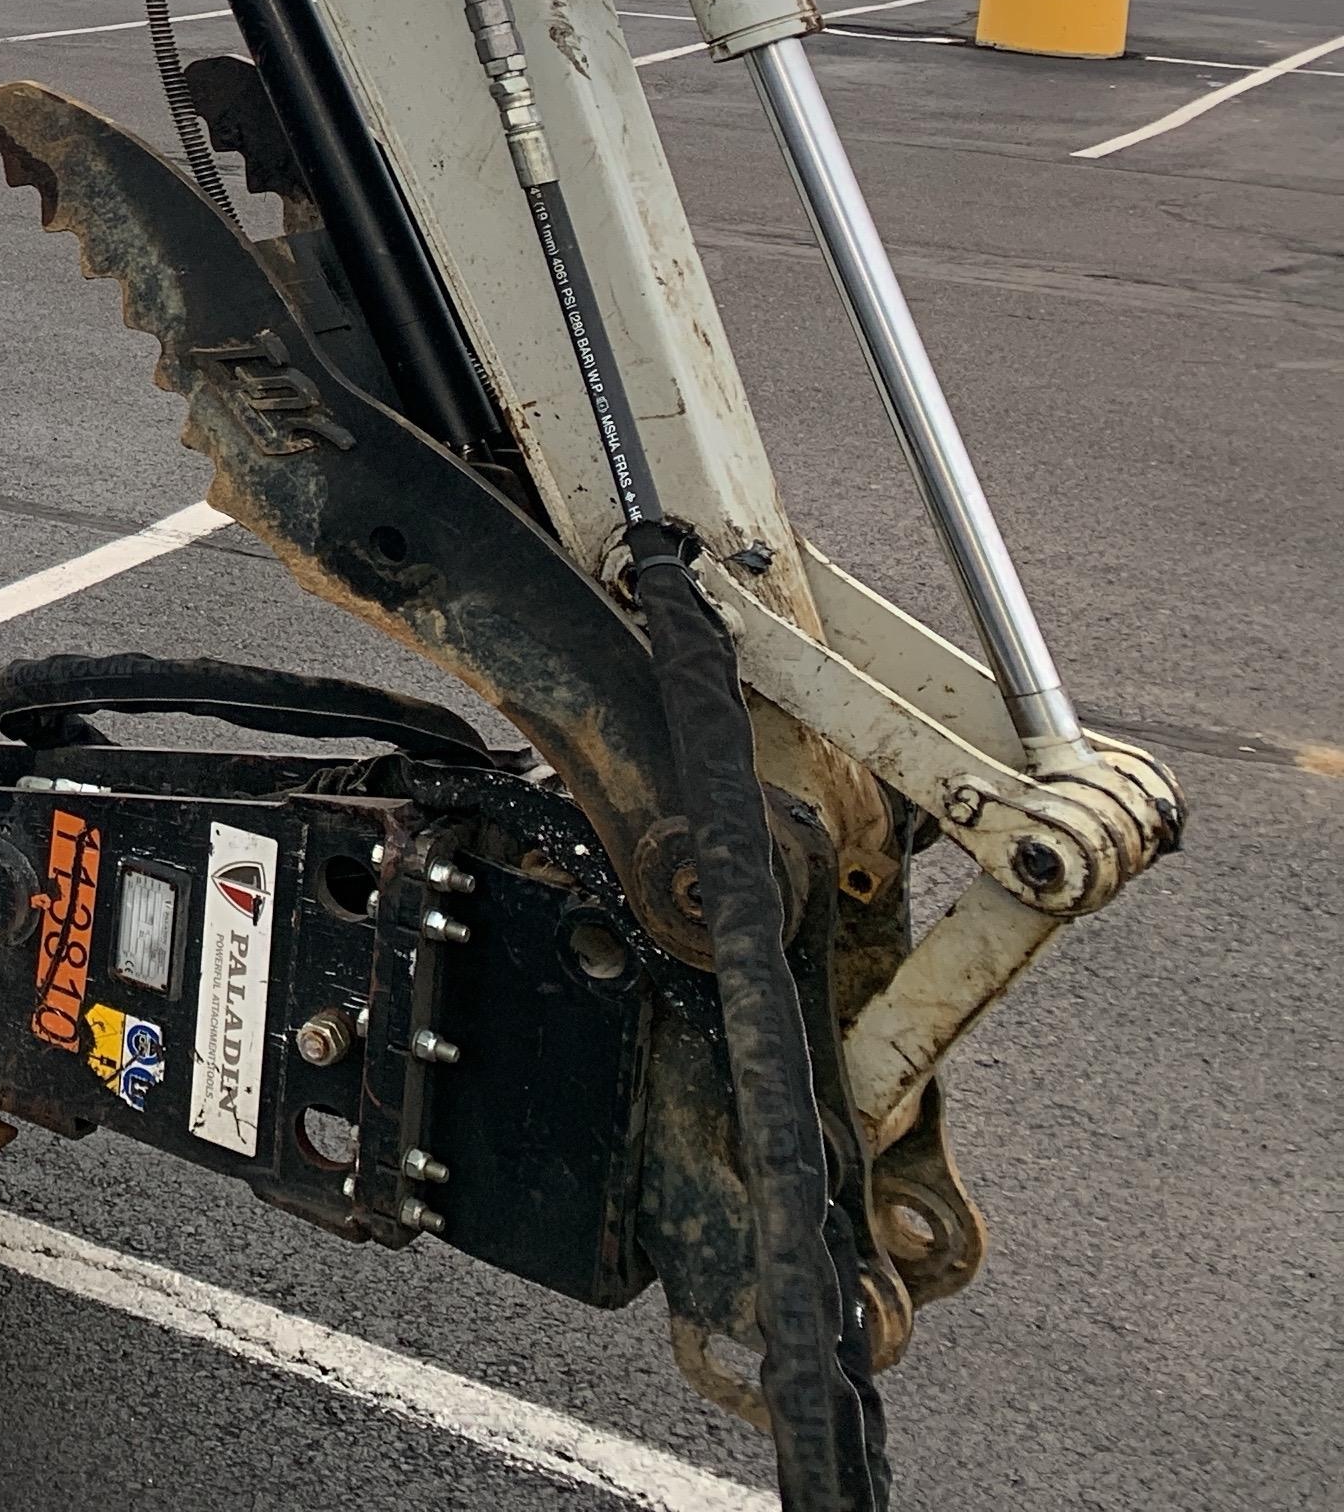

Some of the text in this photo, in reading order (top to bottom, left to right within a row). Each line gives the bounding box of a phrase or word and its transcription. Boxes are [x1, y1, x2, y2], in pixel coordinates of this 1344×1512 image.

[552, 258, 569, 285] 4061
[561, 287, 578, 310] PSI
[568, 311, 586, 337] (280
[577, 337, 596, 368] BAR)
[601, 414, 620, 452] MSHA
[613, 454, 632, 488] FRAS
[212, 932, 225, 989] POWERFUL
[208, 990, 221, 1063] ATTACHMENT
[218, 929, 250, 1114] PALADIN
